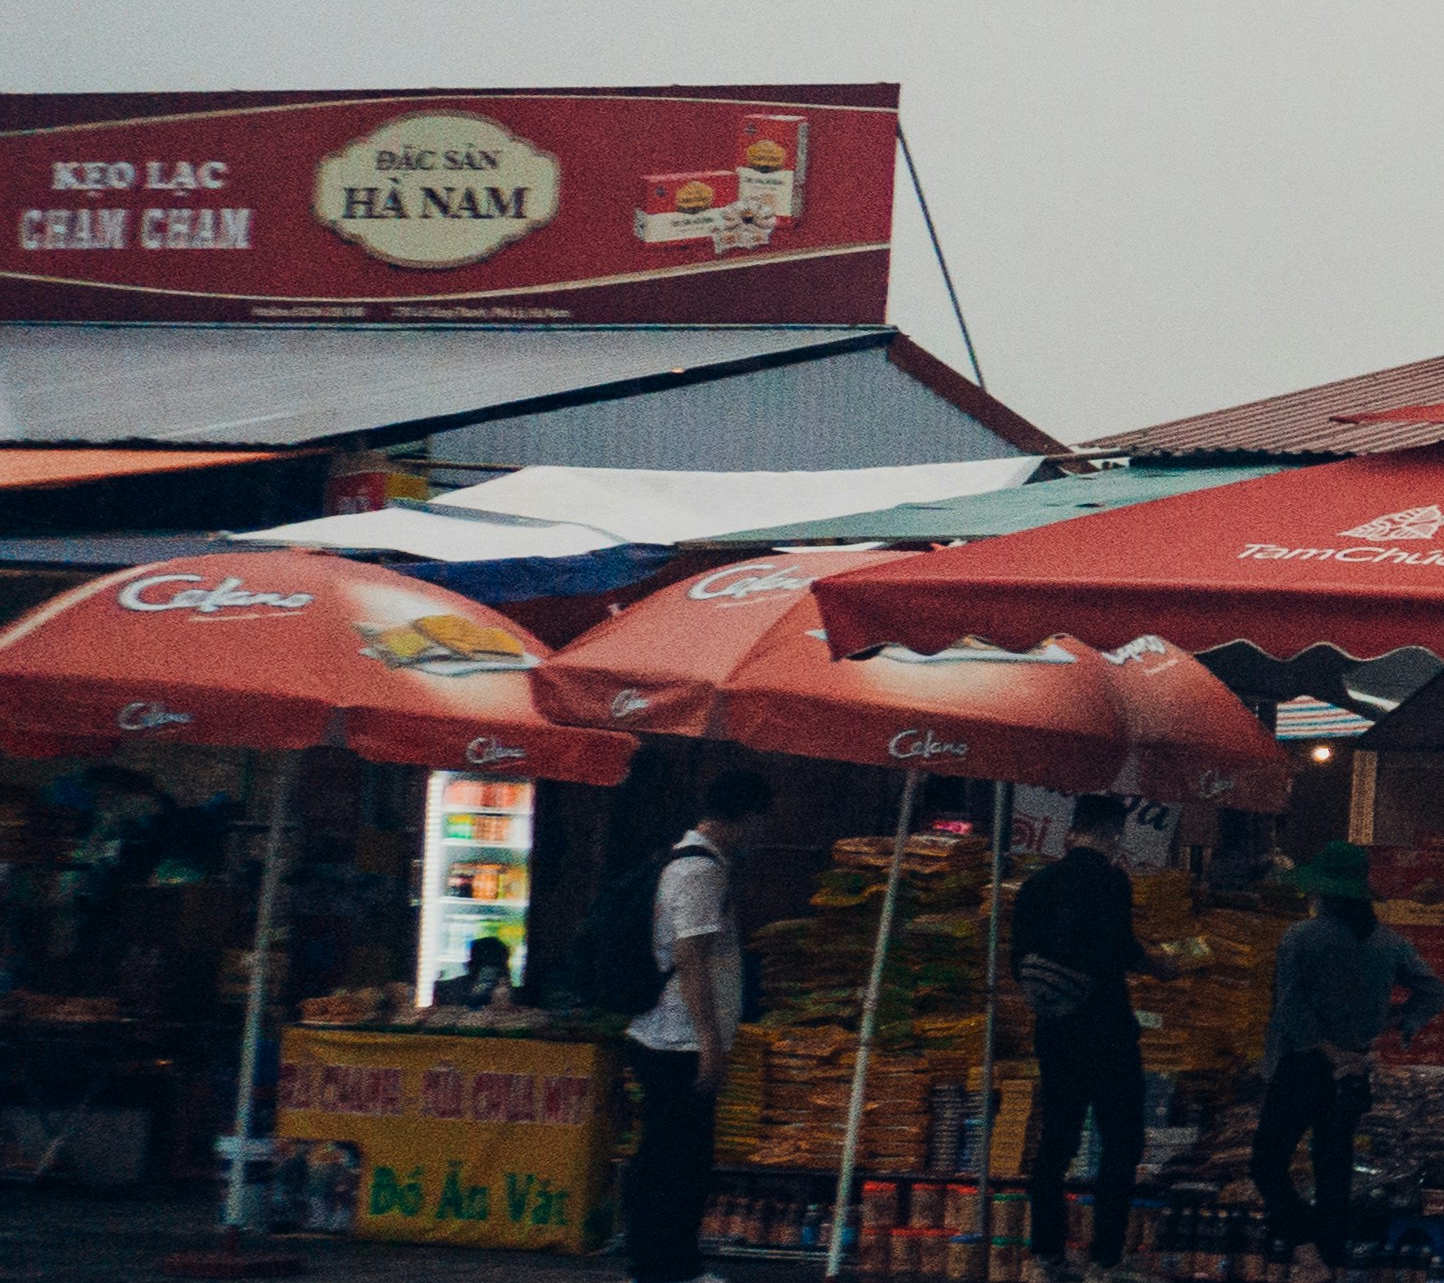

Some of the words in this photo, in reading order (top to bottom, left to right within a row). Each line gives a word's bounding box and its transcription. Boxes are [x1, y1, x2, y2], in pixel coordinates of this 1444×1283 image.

[50, 161, 137, 198] KẸO
[144, 161, 229, 197] LẠC
[343, 177, 409, 219] HÀ
[418, 185, 531, 219] NAM
